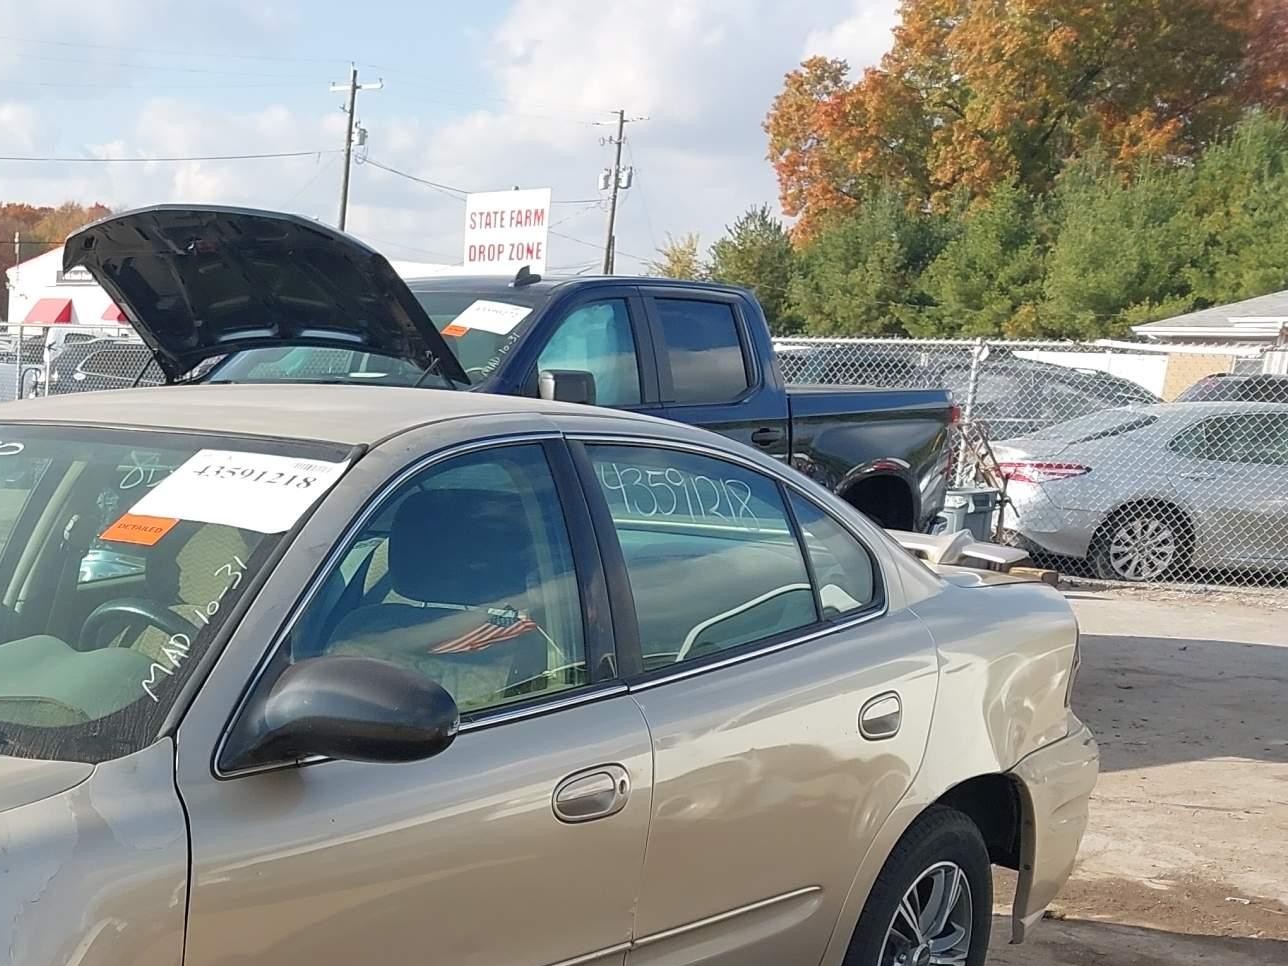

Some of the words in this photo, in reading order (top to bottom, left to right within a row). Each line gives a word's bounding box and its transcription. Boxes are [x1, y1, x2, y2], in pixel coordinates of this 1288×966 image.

[469, 211, 506, 230] STATE
[509, 208, 545, 228] FARM
[468, 244, 505, 262] DROP
[508, 242, 543, 261] ZONE
[192, 464, 318, 489] 43591218
[600, 463, 762, 533] 43591218
[142, 633, 190, 703] MAD
[193, 555, 248, 625] 10-31
